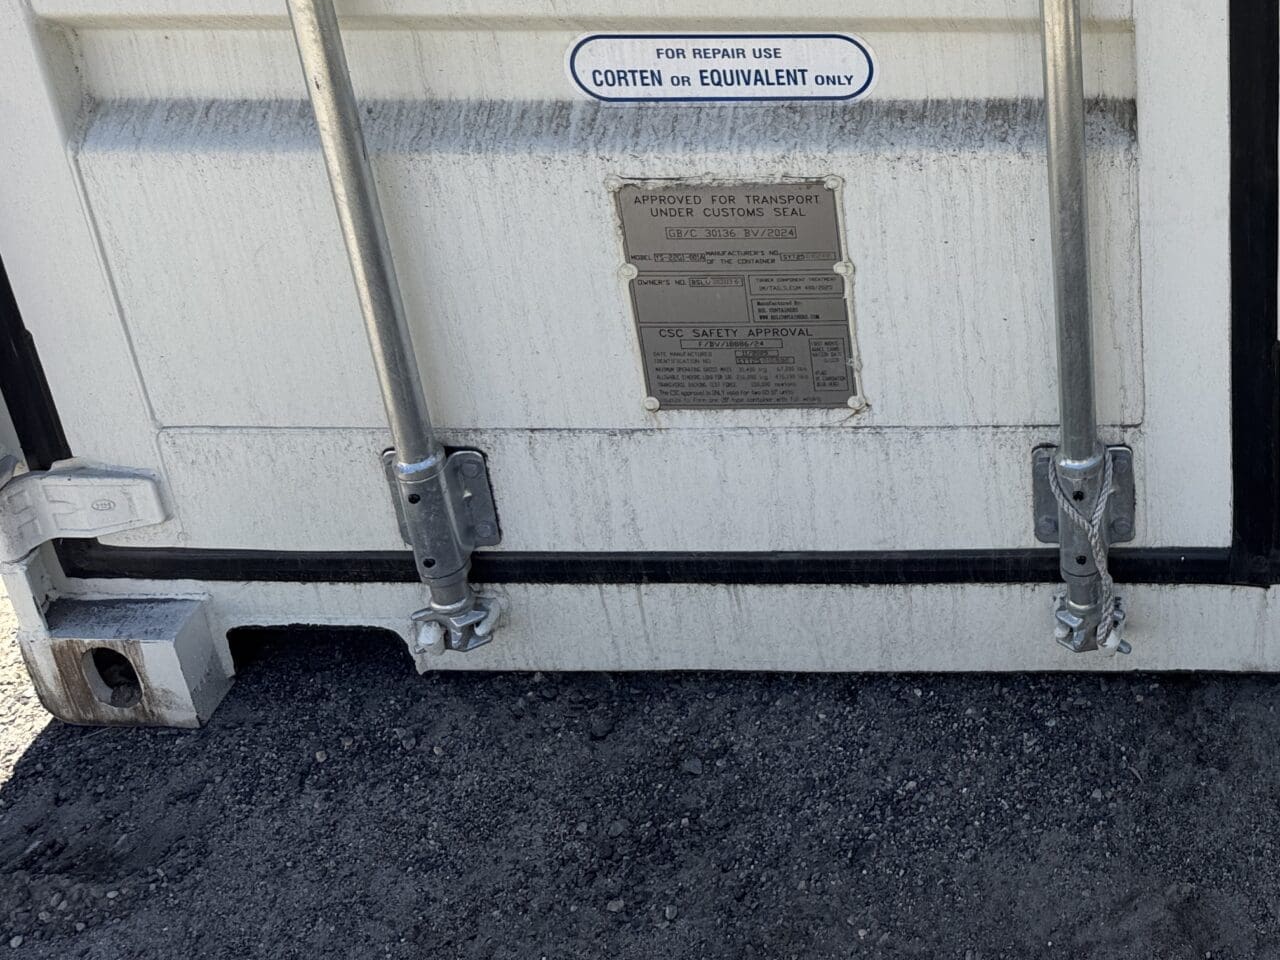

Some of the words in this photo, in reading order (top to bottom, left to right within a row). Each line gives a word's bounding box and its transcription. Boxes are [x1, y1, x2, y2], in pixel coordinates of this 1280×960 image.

[656, 48, 687, 60] FOR
[692, 47, 746, 60] REPAIR
[753, 47, 782, 59] USE
[591, 69, 663, 87] CORTEN
[671, 75, 692, 87] OR
[699, 68, 808, 86] EQUIVALENT
[814, 74, 854, 86] ONLY
[633, 195, 702, 205] APPROVED
[711, 195, 736, 205] FOR
[745, 194, 820, 205] TRANSPORT
[650, 207, 694, 217] UNDER
[703, 207, 764, 218] CUSTOMS
[774, 207, 806, 217] SEAL
[668, 229, 697, 238] GB/C
[705, 229, 736, 238] 30136
[744, 228, 795, 237] BV/2024
[659, 328, 684, 338] CSC
[692, 328, 738, 338] SAFETY
[748, 327, 813, 337] APPROVAL
